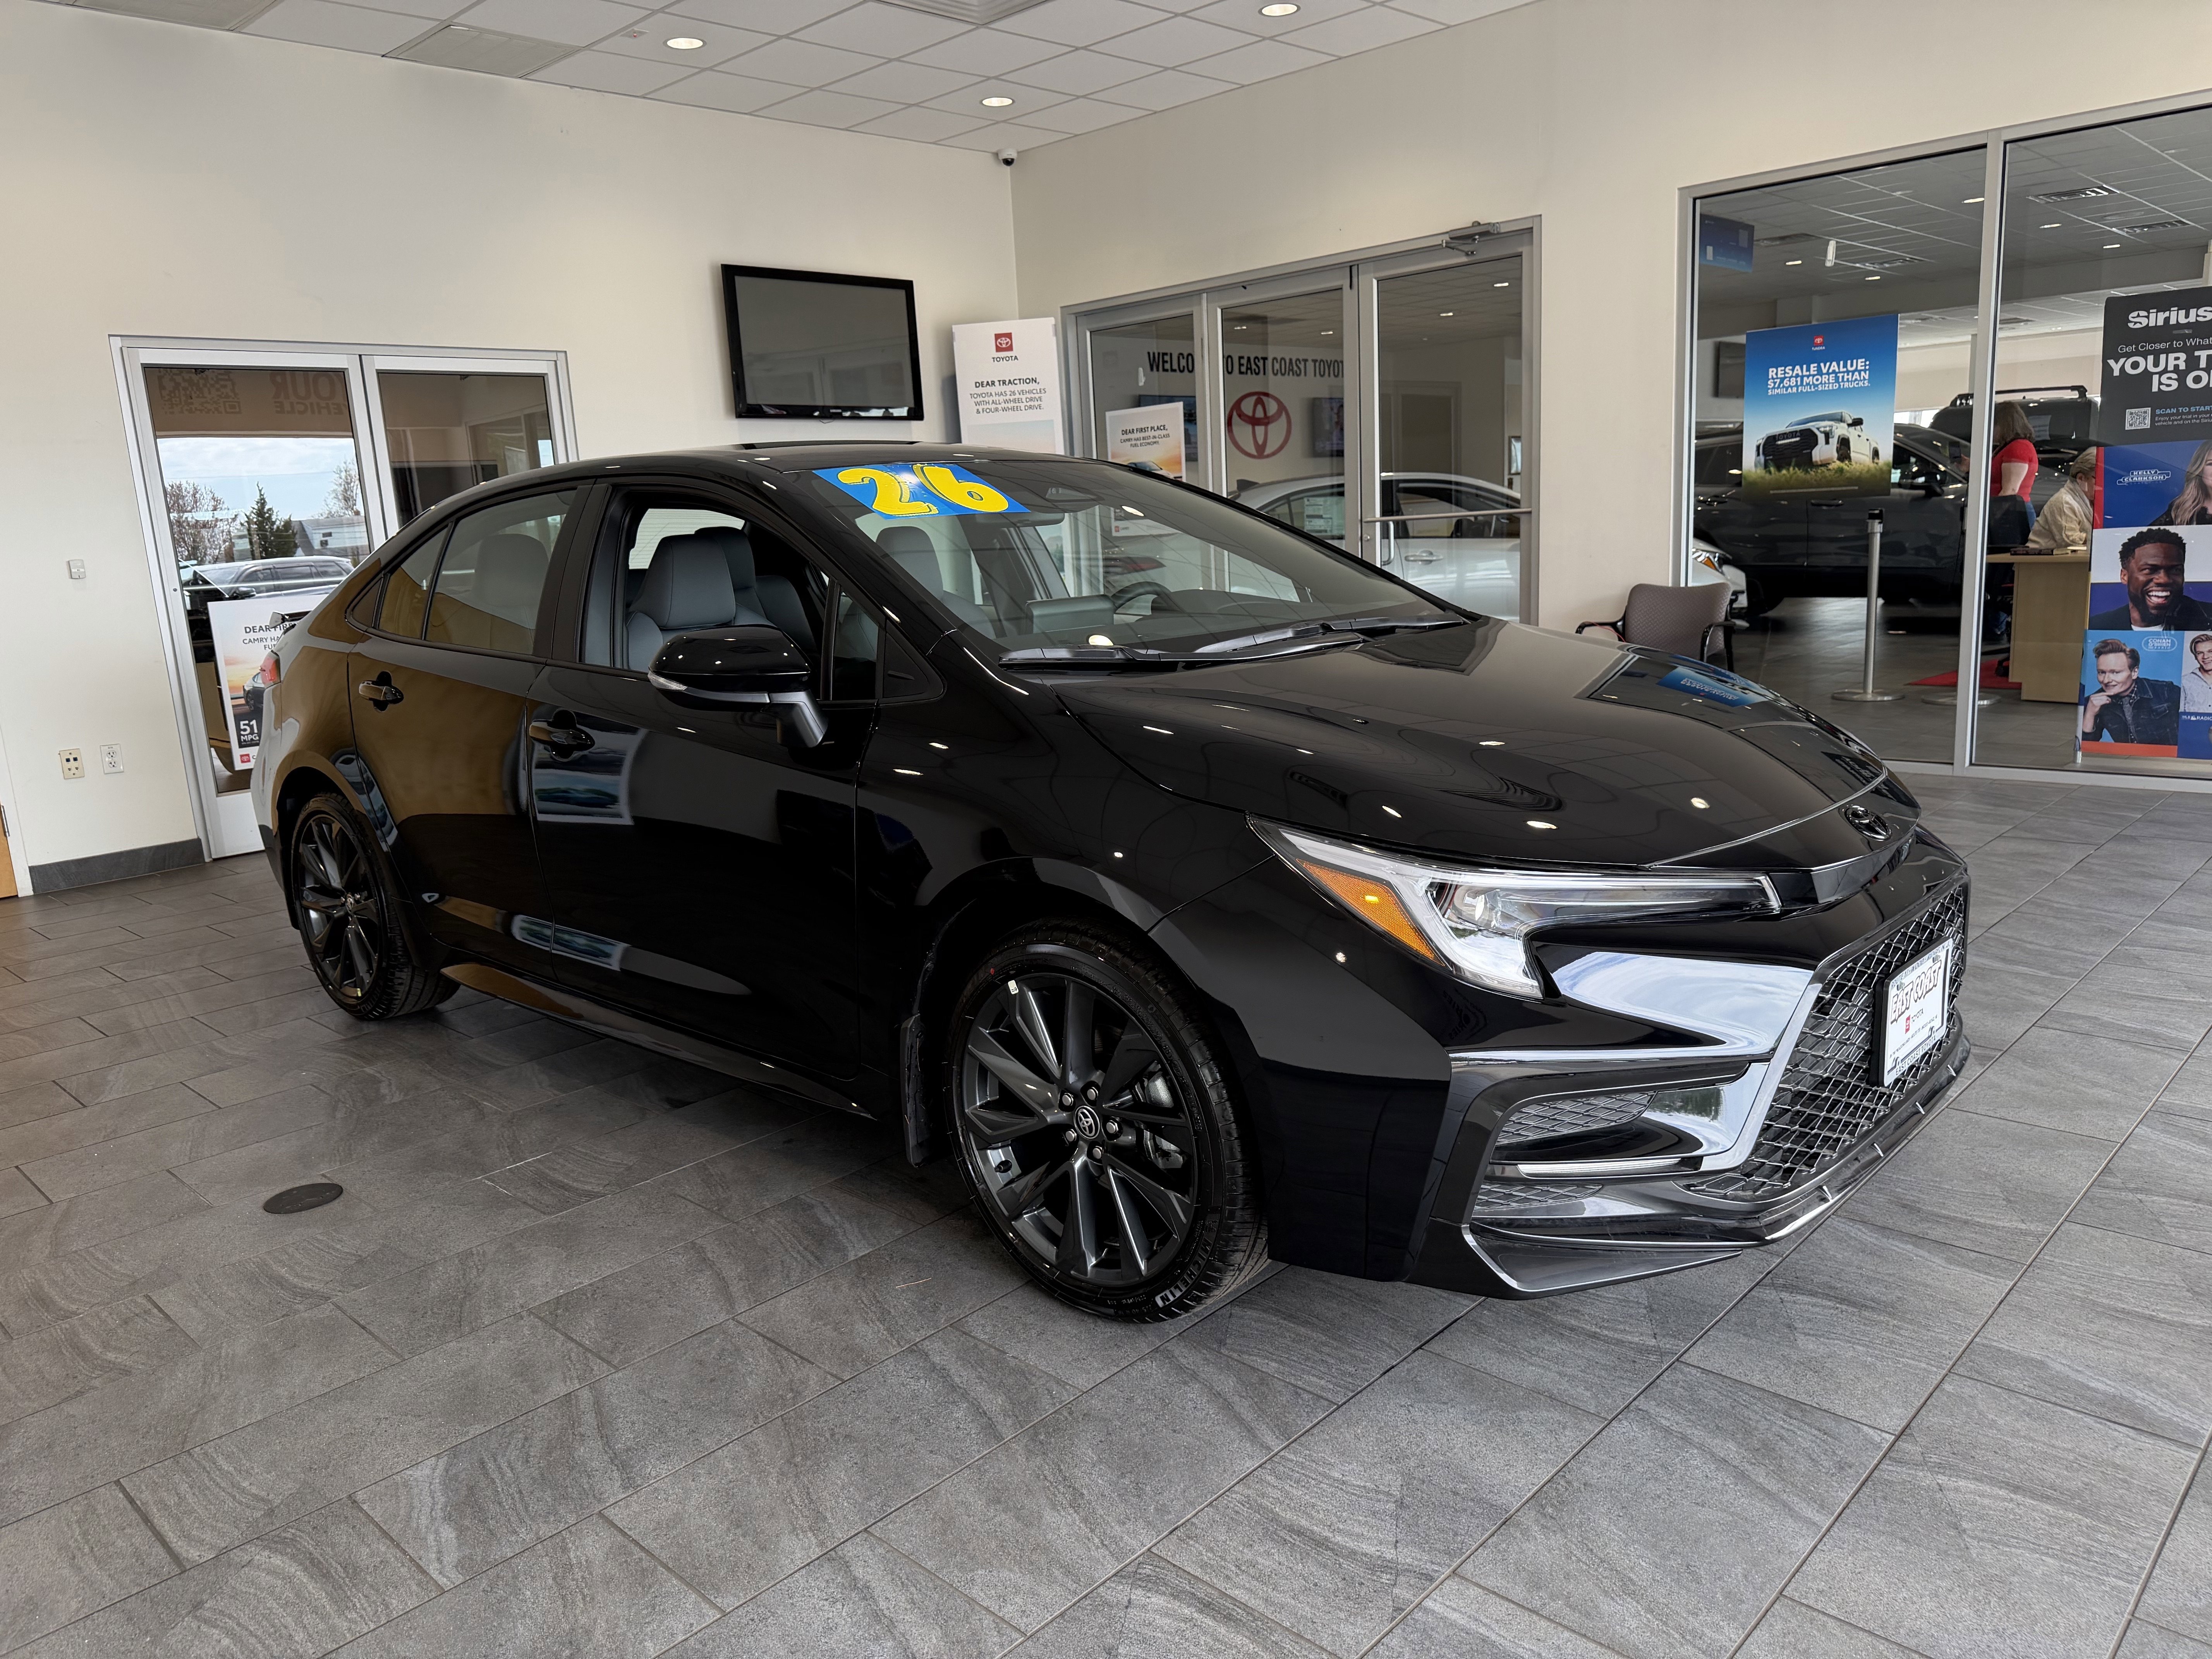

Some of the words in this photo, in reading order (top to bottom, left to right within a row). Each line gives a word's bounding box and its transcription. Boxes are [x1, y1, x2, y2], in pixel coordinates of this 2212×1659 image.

[2128, 306, 2212, 328] Sirius
[2138, 342, 2171, 351] Closer
[2186, 337, 2212, 347] What
[1147, 351, 1194, 373] WELCO
[1224, 355, 1233, 374] O
[1238, 356, 1268, 376] EAST
[1272, 357, 1308, 377] COAST
[1768, 363, 1818, 379] RESALE
[1820, 358, 1870, 374] VALUE:
[2107, 352, 2186, 376] YOUR
[997, 377, 1040, 386] TRACTION,
[1767, 376, 1800, 388] $7,681
[1803, 374, 1835, 385] MORE
[1837, 371, 1869, 382] THAN
[1768, 386, 1797, 395] SIMILAR
[1798, 383, 1838, 393] FULL-SIZED
[1840, 380, 1871, 389] TRUCKS.
[2152, 373, 2179, 392] IS
[2186, 369, 2212, 389] O
[982, 405, 1023, 414] FOUR-WHEEL
[991, 397, 1024, 405] ALL-WHEEL
[837, 464, 1009, 517] 26
[244, 625, 271, 634] DEAR
[240, 720, 258, 735] 51
[1891, 981, 1914, 1025] EAST
[1913, 959, 1942, 1003] COAST
[1896, 1061, 1907, 1075] EAST
[1907, 1048, 1922, 1066] COAST
[1922, 1035, 1936, 1052] TOYOTA
[1159, 1237, 1212, 1305] MICHELIN
